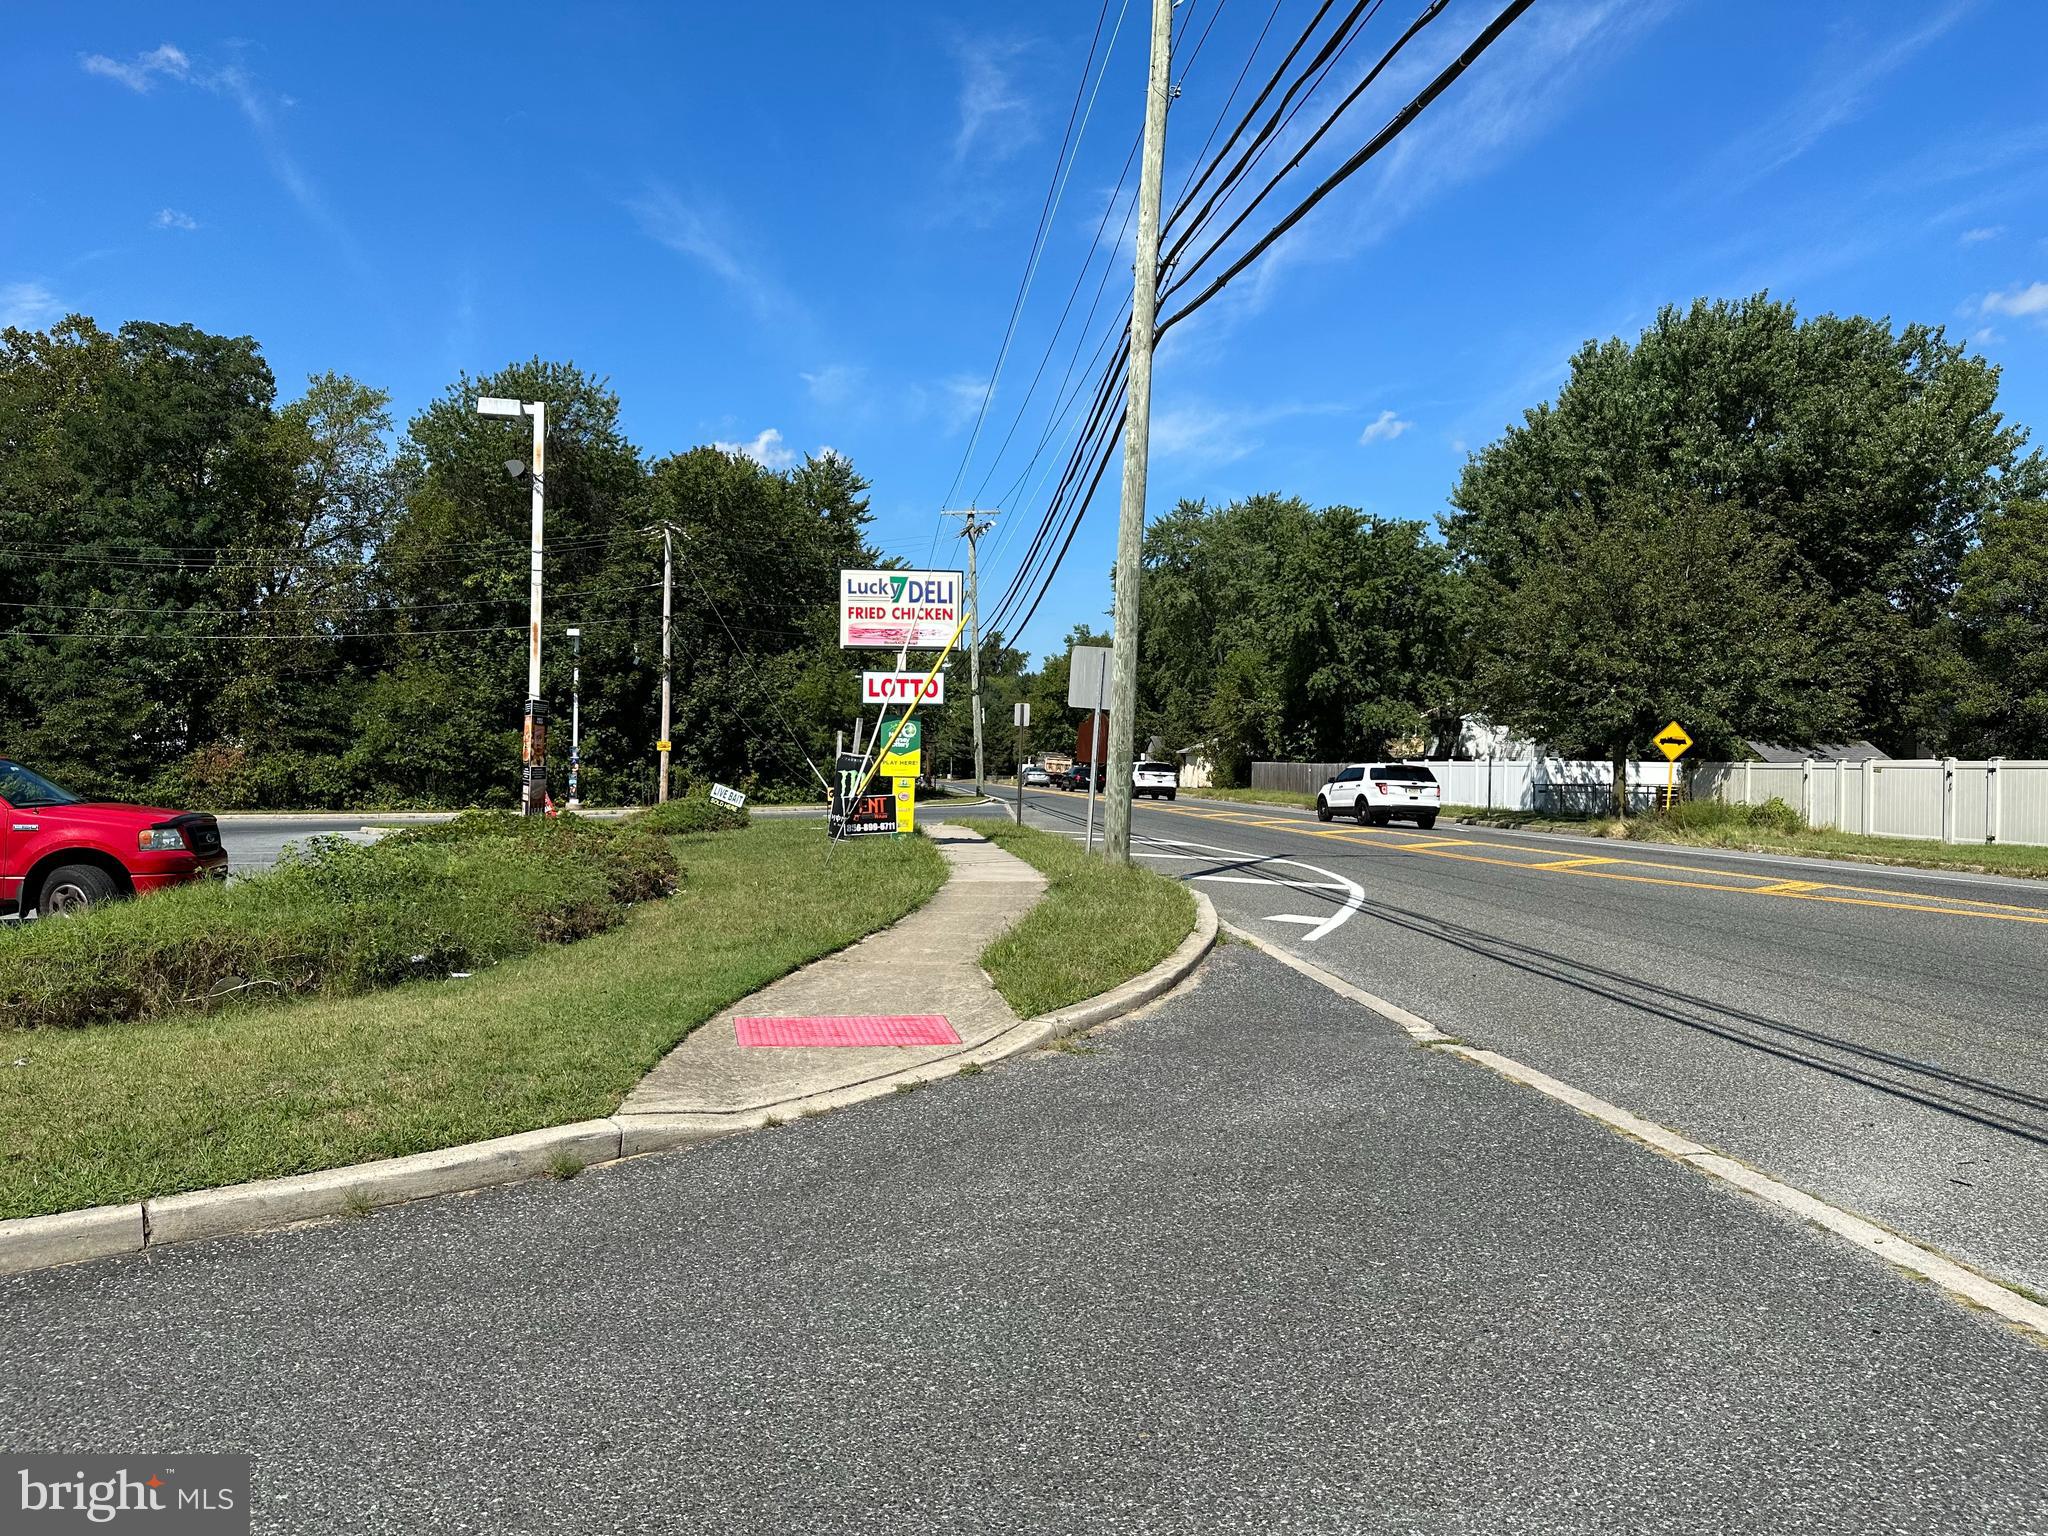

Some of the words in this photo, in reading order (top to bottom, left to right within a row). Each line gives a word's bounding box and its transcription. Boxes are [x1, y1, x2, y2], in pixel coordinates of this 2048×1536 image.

[848, 578, 901, 600] Lucky
[889, 576, 909, 603] 7
[908, 581, 953, 604] DELI
[848, 607, 886, 619] FRIED
[892, 607, 953, 620] CHICKEN
[868, 678, 938, 698] LOTTO
[710, 797, 724, 807] SOLD
[713, 785, 729, 799] LIVE
[728, 791, 744, 805] BAIT
